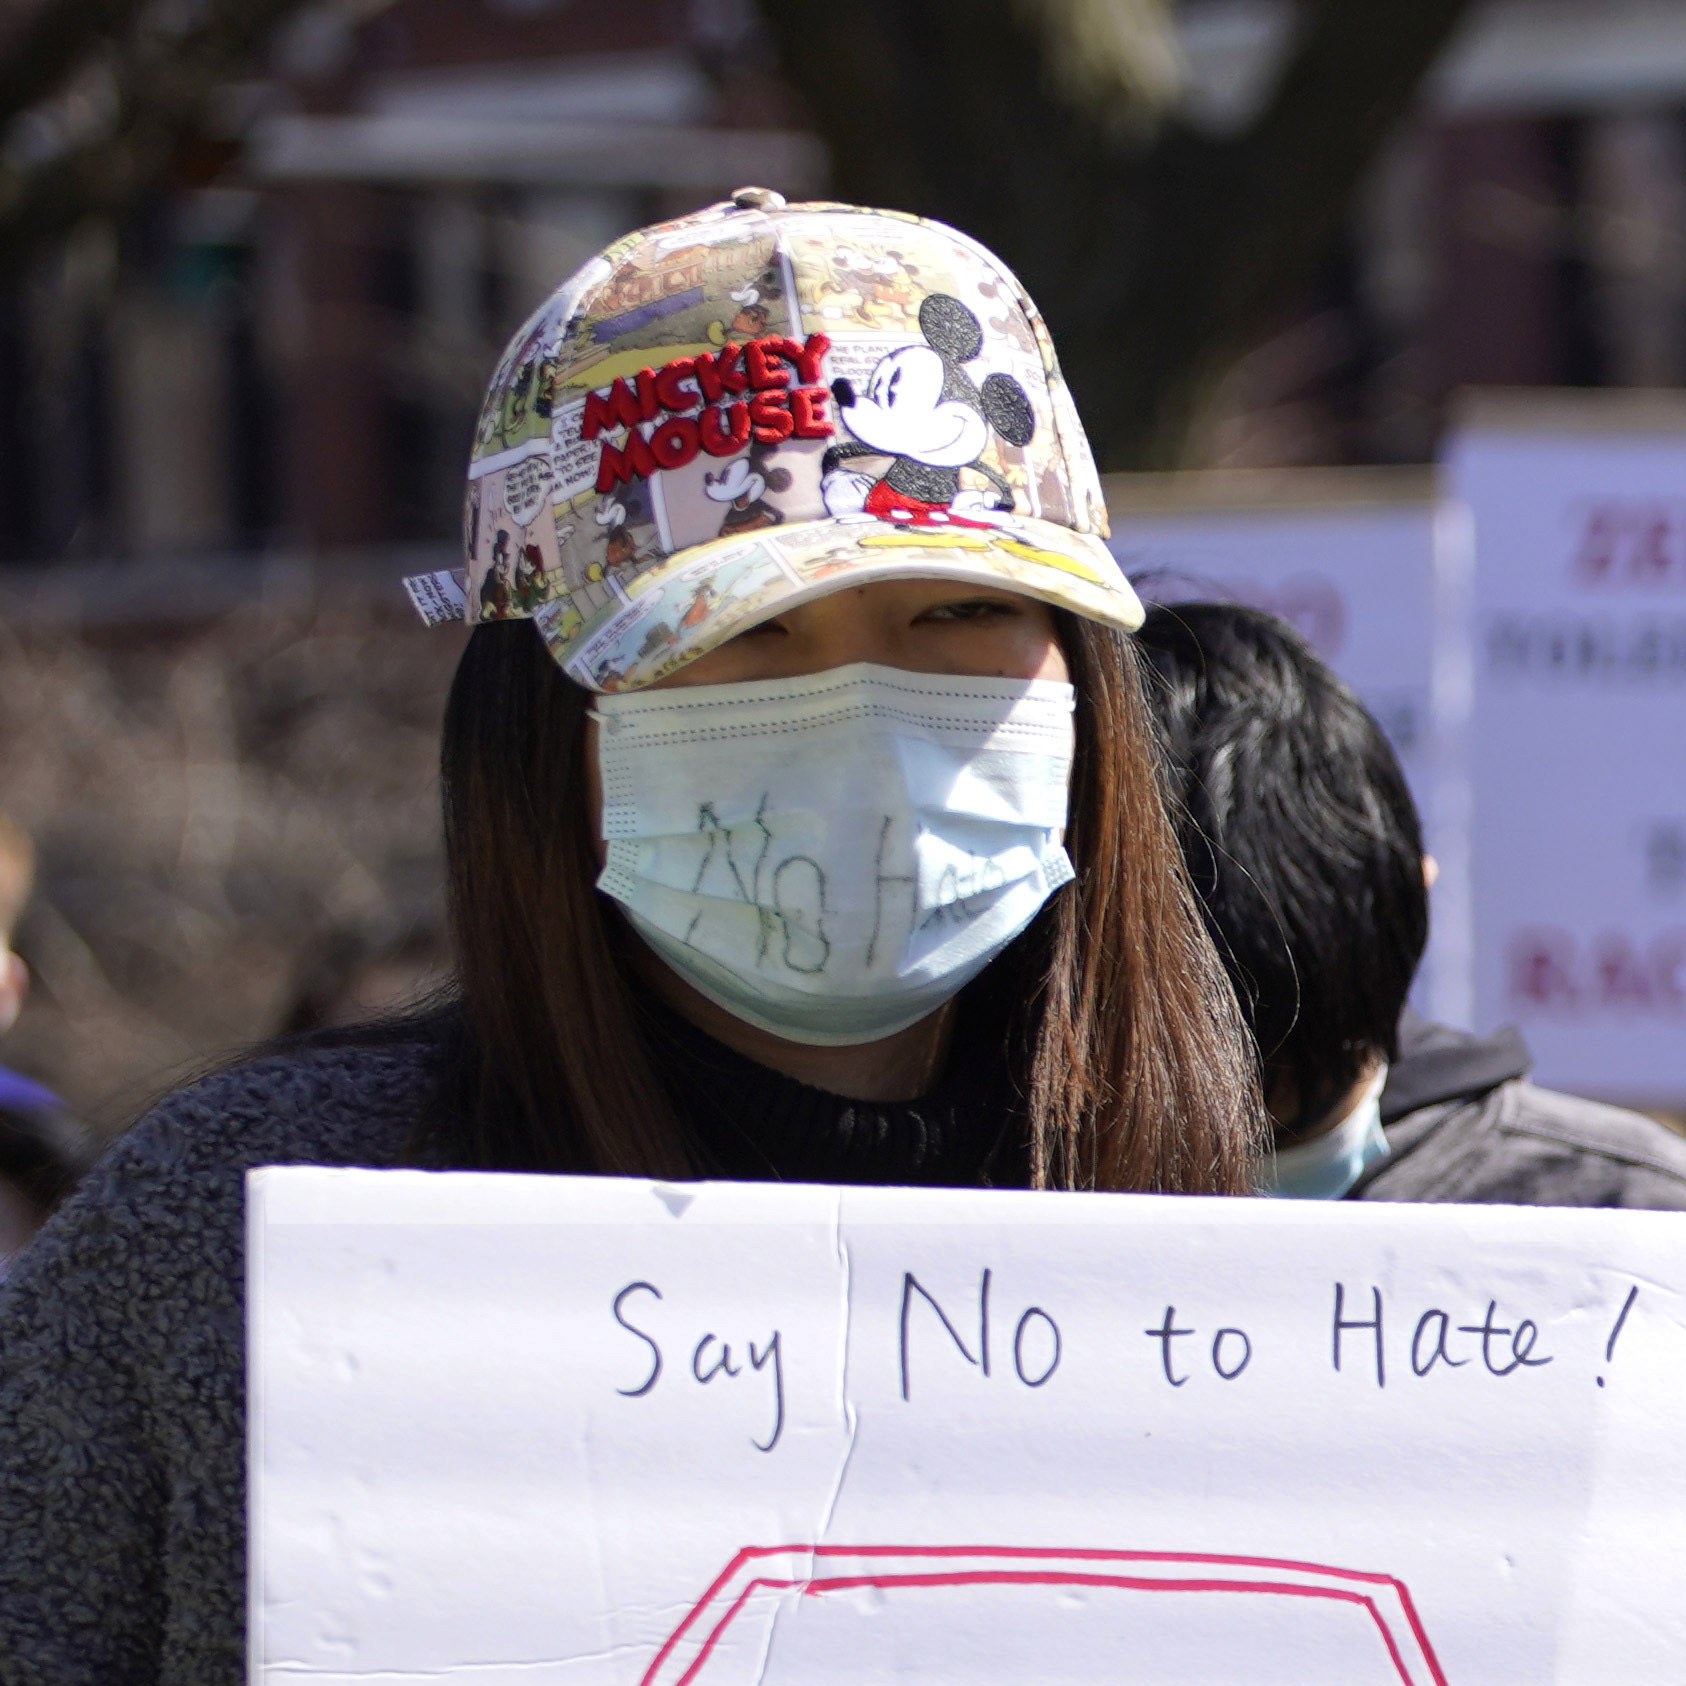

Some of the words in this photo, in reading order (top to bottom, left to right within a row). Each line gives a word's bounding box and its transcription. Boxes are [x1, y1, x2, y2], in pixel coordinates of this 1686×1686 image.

[582, 332, 831, 440] MICKEY
[596, 387, 834, 492] MOUSE
[614, 1282, 784, 1453] Say
[901, 1268, 1060, 1401] No
[1145, 1306, 1251, 1387] to
